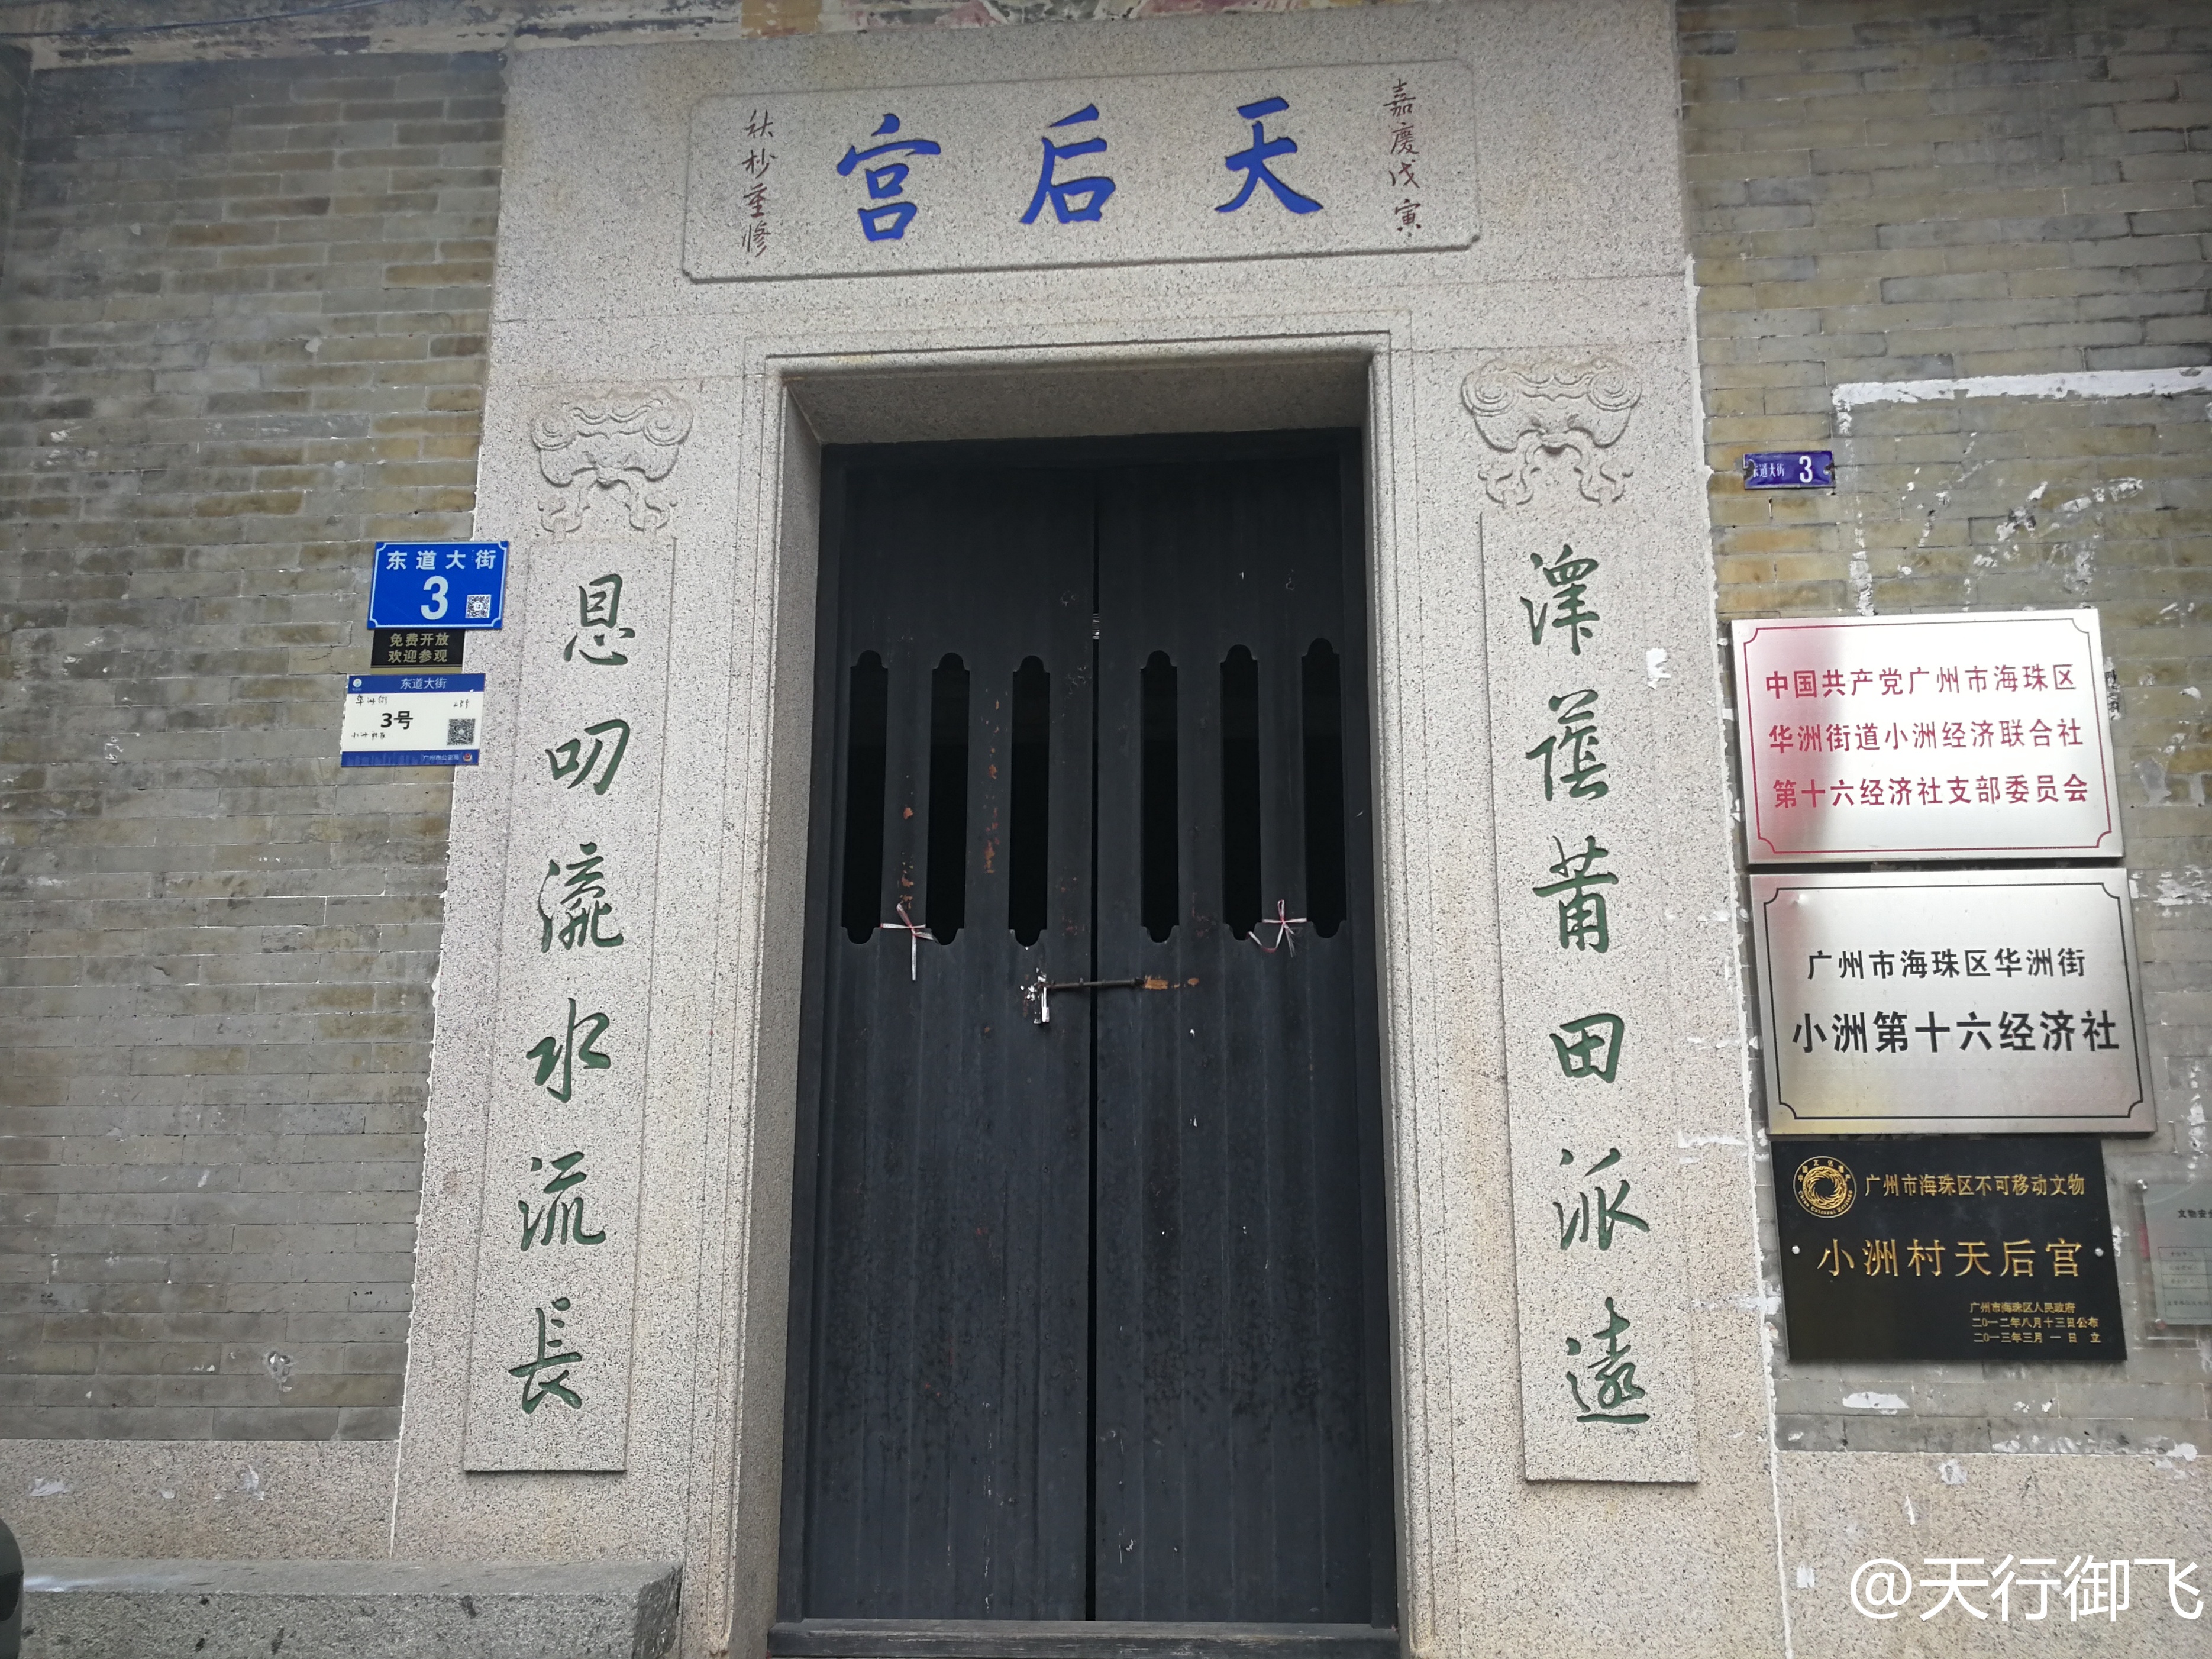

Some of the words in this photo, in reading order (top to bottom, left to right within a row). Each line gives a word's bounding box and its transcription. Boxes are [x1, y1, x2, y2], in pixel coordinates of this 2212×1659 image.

[836, 96, 1324, 243] 天后宫
[1799, 456, 1813, 483] 3
[386, 549, 496, 570] 东道大街
[421, 575, 449, 621] 3
[389, 633, 450, 647] 免费开放
[388, 650, 448, 664] 欢迎参观
[400, 678, 447, 689] 东道大街
[1765, 663, 2077, 700] 中国共产党广州市海珠区
[380, 711, 414, 730] 3号
[1769, 718, 2084, 754] 华洲街道小洲经济联合社
[1773, 773, 2089, 809] 第十六经济社支部委员会
[1807, 947, 2085, 980] 广州市海珠区华洲街
[1791, 1009, 2119, 1054] 小洲第十六经济社
[1865, 1173, 2085, 1196] 广州市海珠区不可移动文物
[1817, 1238, 2083, 1277] 小洲村天后宫
[1969, 1302, 2076, 1313] 广州市海珠区人民政府
